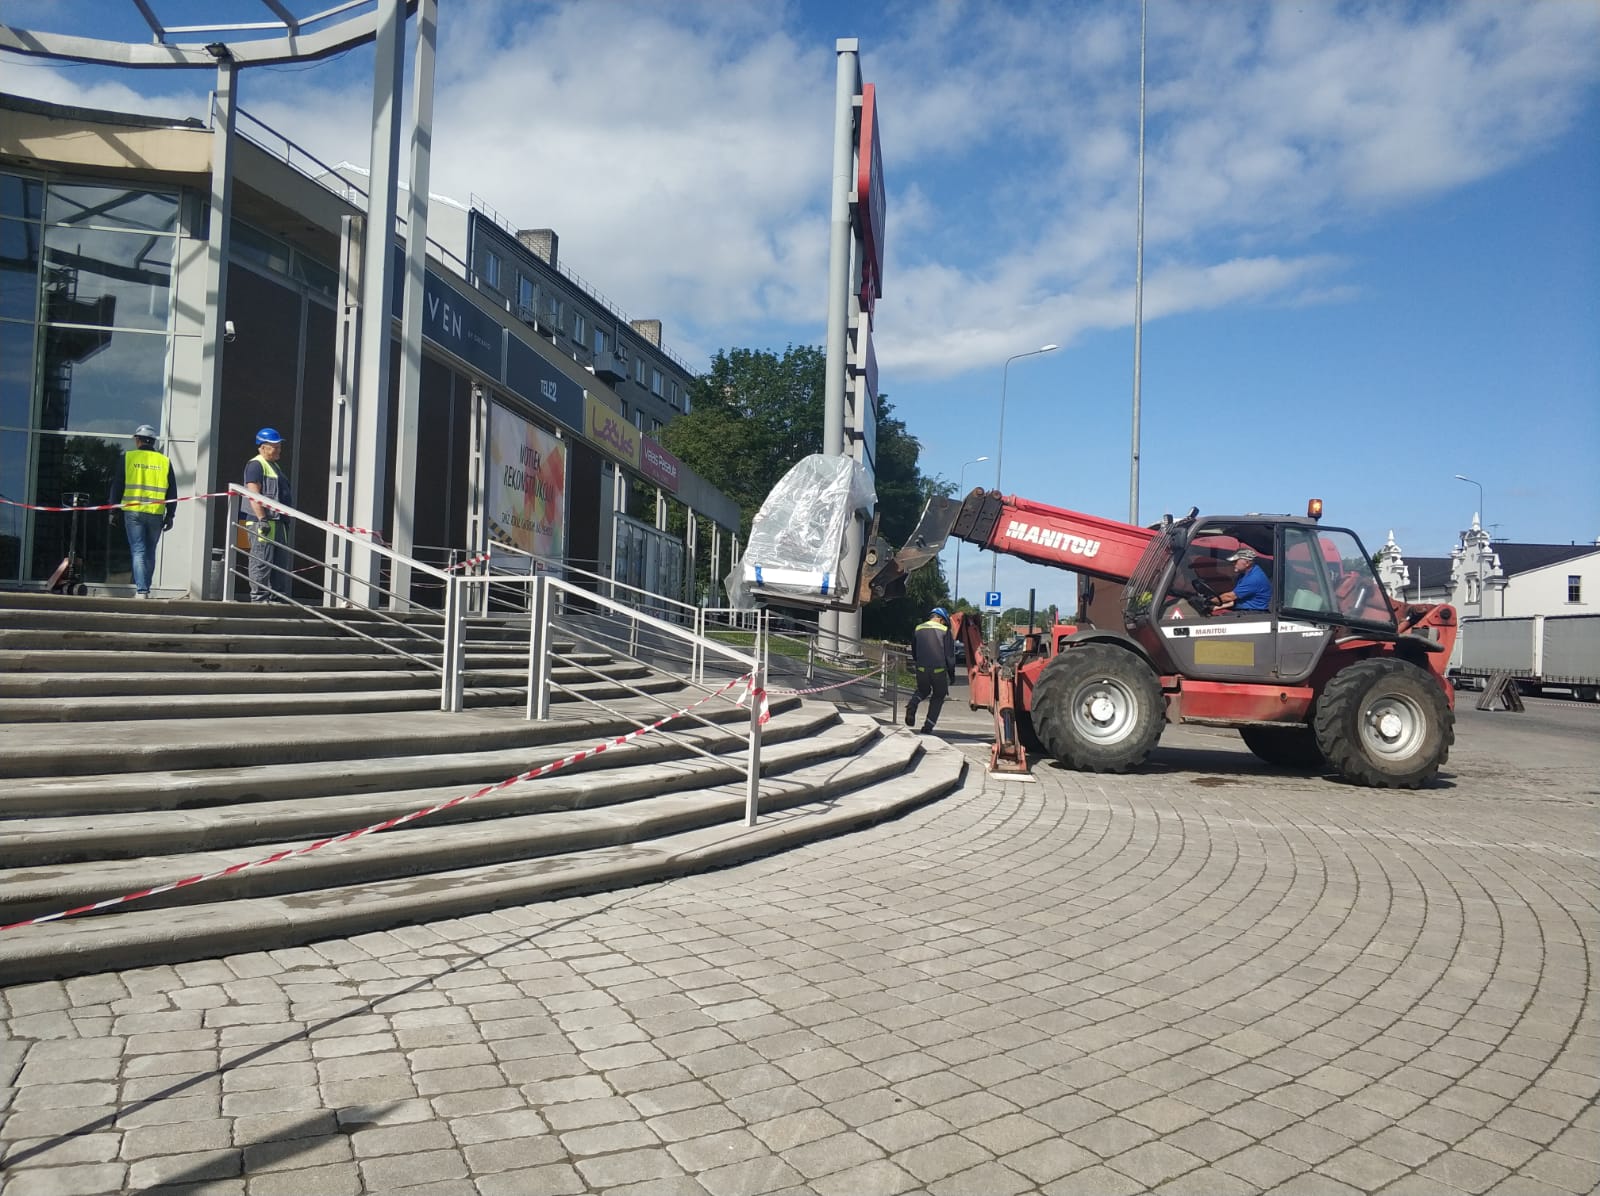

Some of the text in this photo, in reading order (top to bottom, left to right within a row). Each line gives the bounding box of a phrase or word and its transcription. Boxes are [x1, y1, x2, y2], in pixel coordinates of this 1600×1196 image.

[519, 443, 542, 473] NOTIEK
[1005, 520, 1101, 558] MANITOU
[989, 593, 1000, 605] P
[1195, 627, 1227, 635] MANITOU
